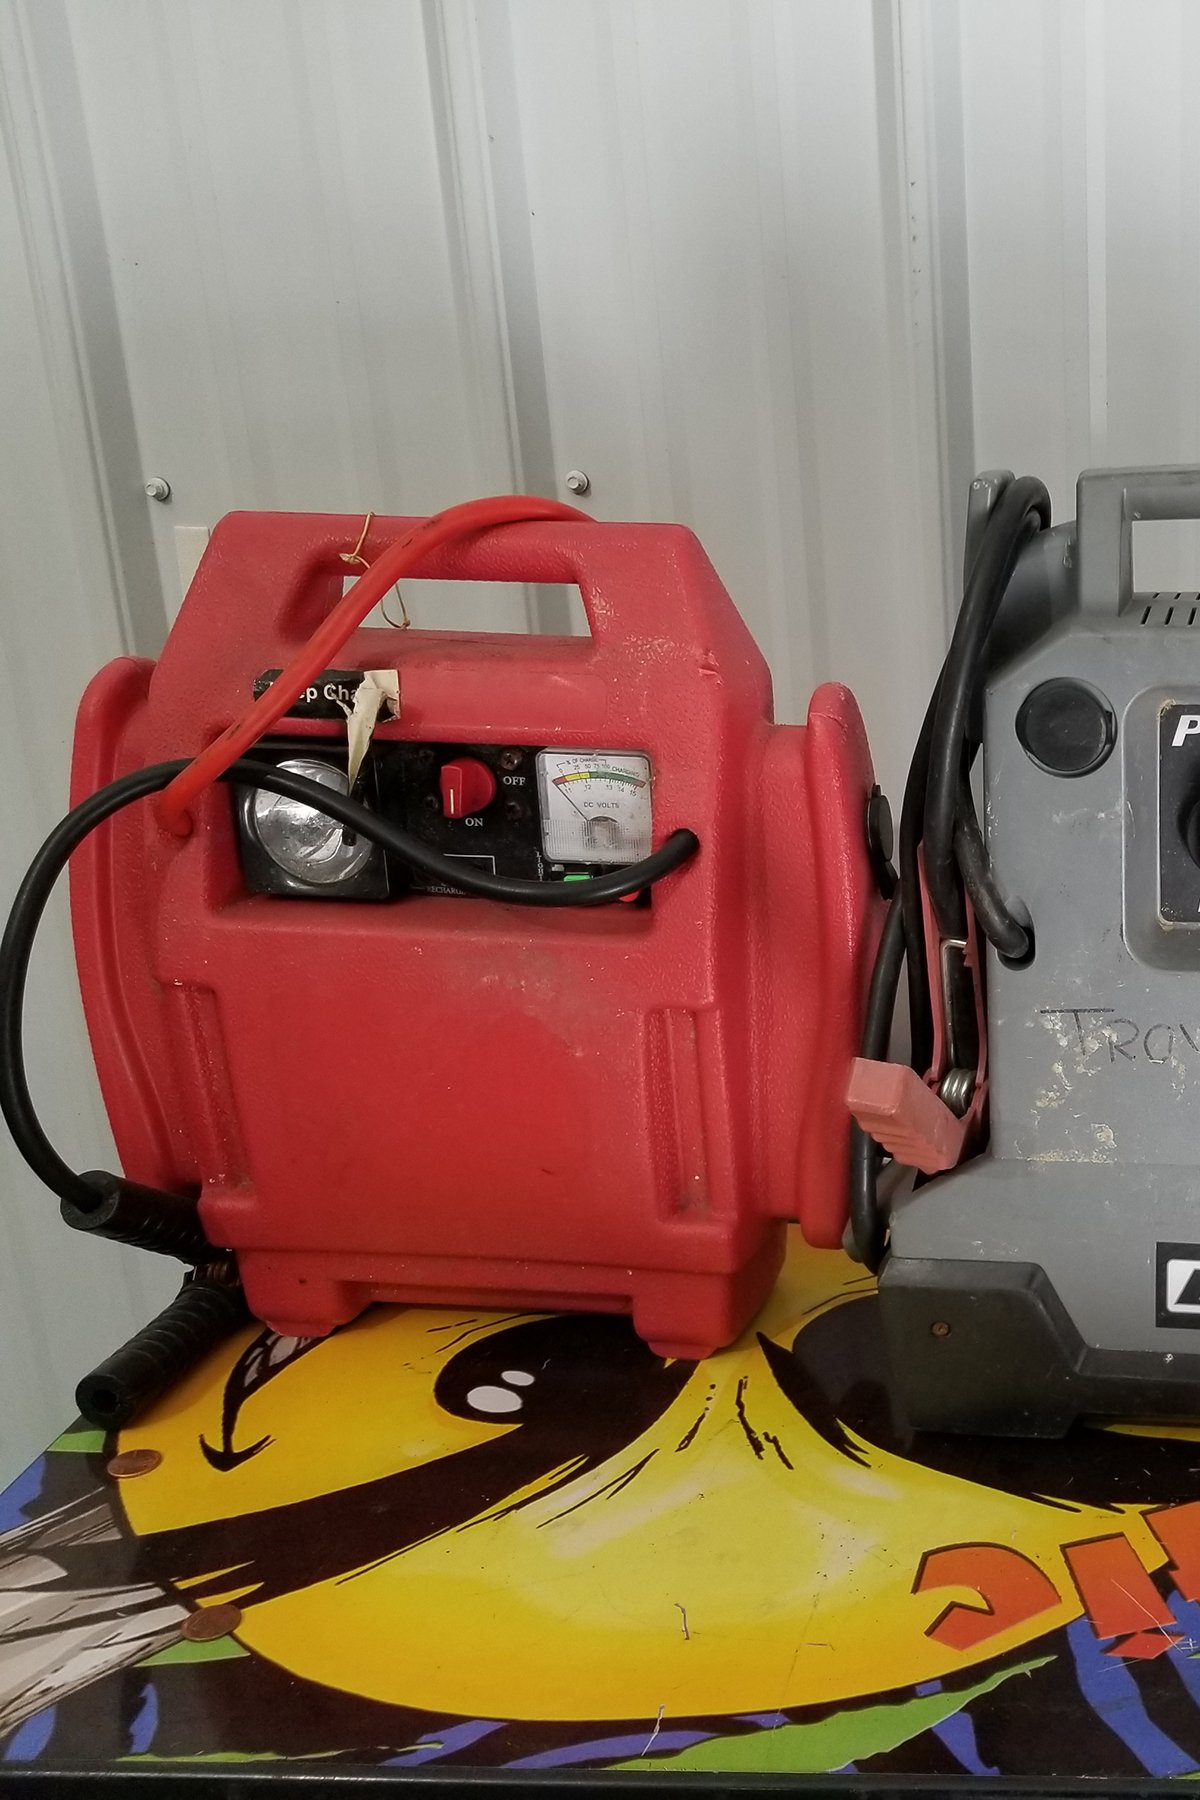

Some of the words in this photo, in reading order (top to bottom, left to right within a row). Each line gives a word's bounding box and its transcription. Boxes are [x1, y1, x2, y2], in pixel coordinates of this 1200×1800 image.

[503, 775, 526, 787] OFF
[597, 801, 620, 809] VOLTS
[465, 817, 484, 828] ON
